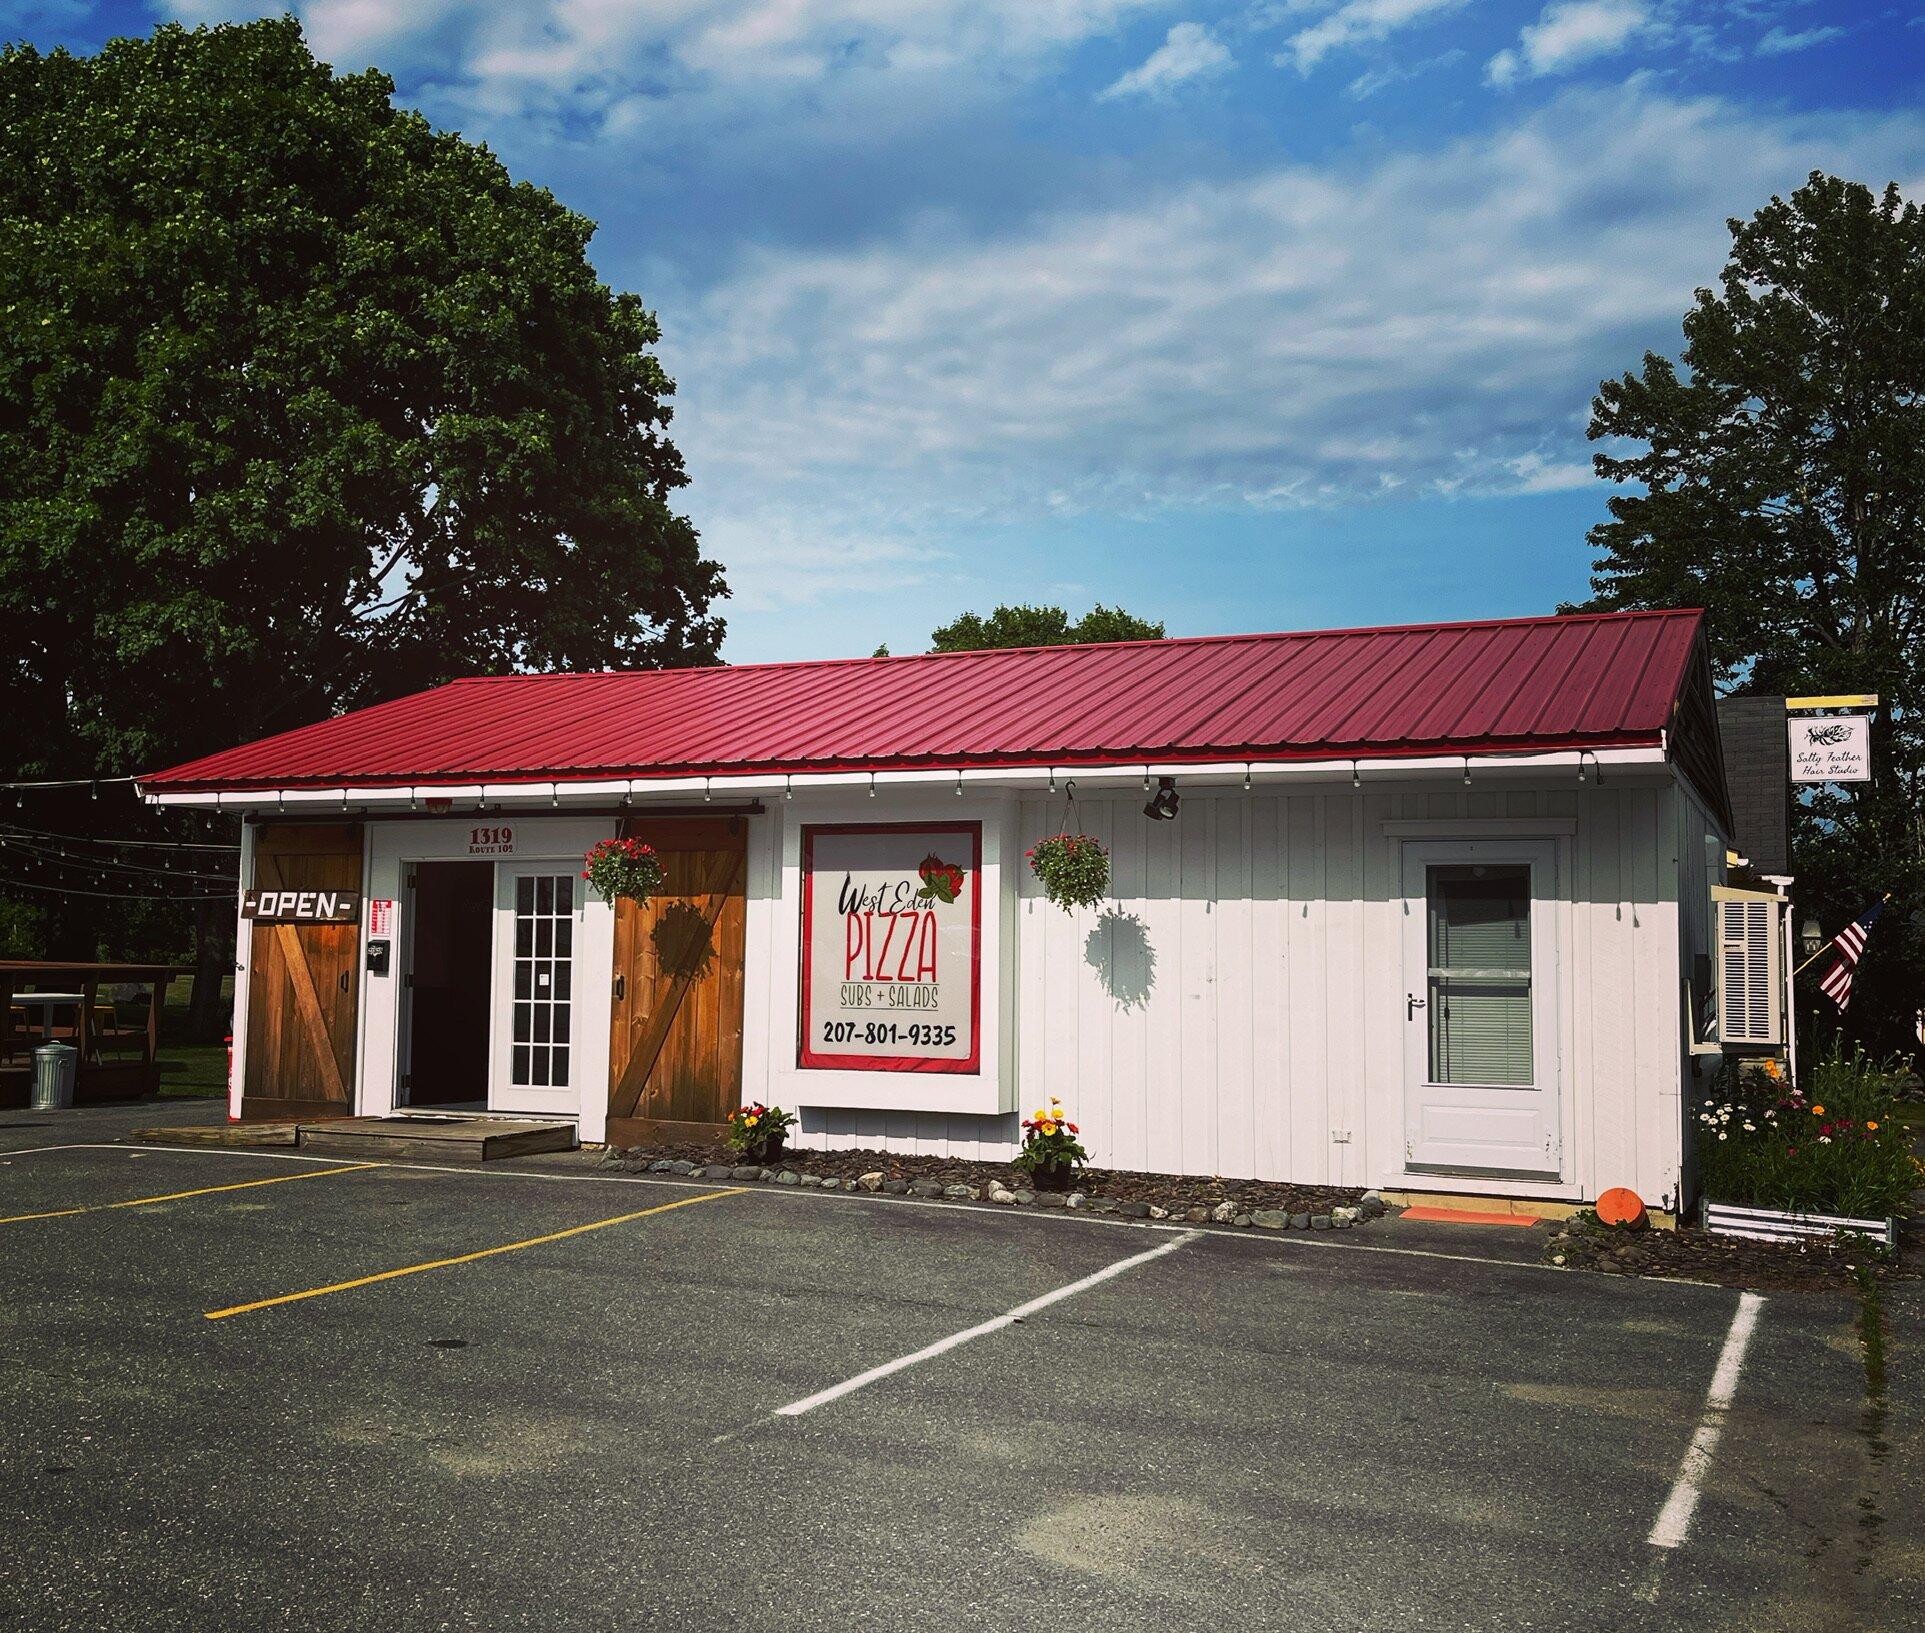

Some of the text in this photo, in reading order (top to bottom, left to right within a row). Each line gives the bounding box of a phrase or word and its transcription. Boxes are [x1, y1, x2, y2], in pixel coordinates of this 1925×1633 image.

[1797, 751, 1862, 766] Salty Feather
[1802, 765, 1858, 774] Hair Studio
[470, 827, 513, 844] 1319
[839, 871, 936, 917] West Eden
[846, 911, 937, 982] PIZZA
[841, 984, 872, 1007] SUBS
[889, 984, 938, 1008] SALADS
[824, 1022, 956, 1046] 207-801-9335
